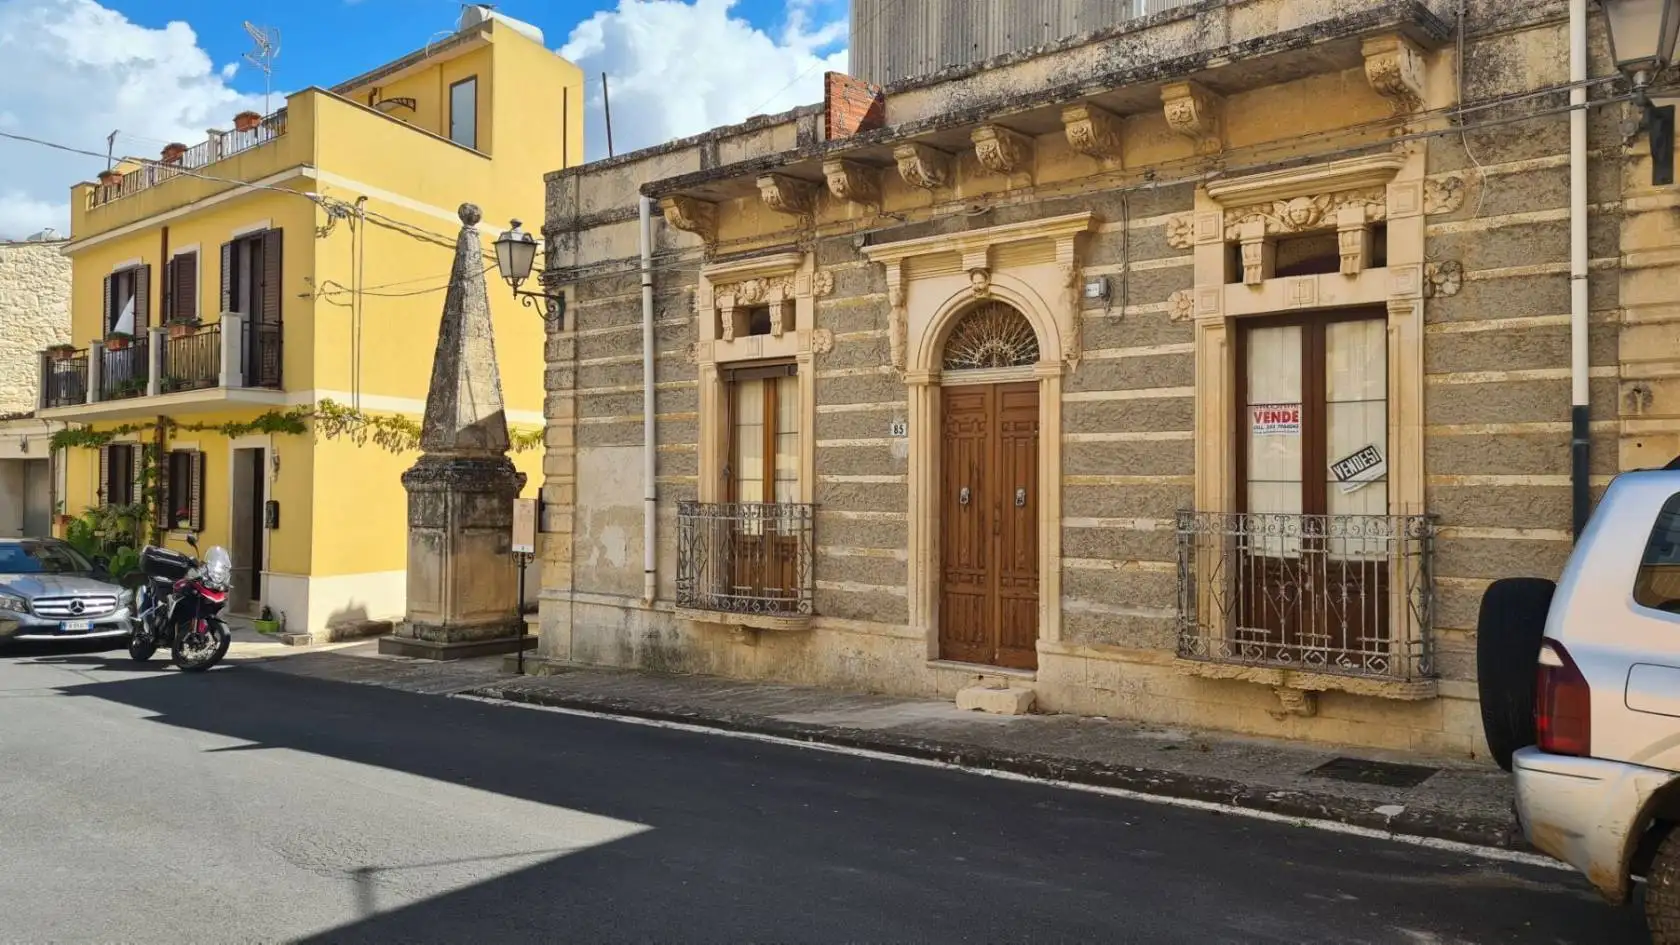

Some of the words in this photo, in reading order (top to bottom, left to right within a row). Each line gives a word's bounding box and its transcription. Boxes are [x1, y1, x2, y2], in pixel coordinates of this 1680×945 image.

[1254, 411, 1299, 423] VENDE
[893, 424, 904, 435] 85
[1332, 447, 1380, 480] VENDESI
